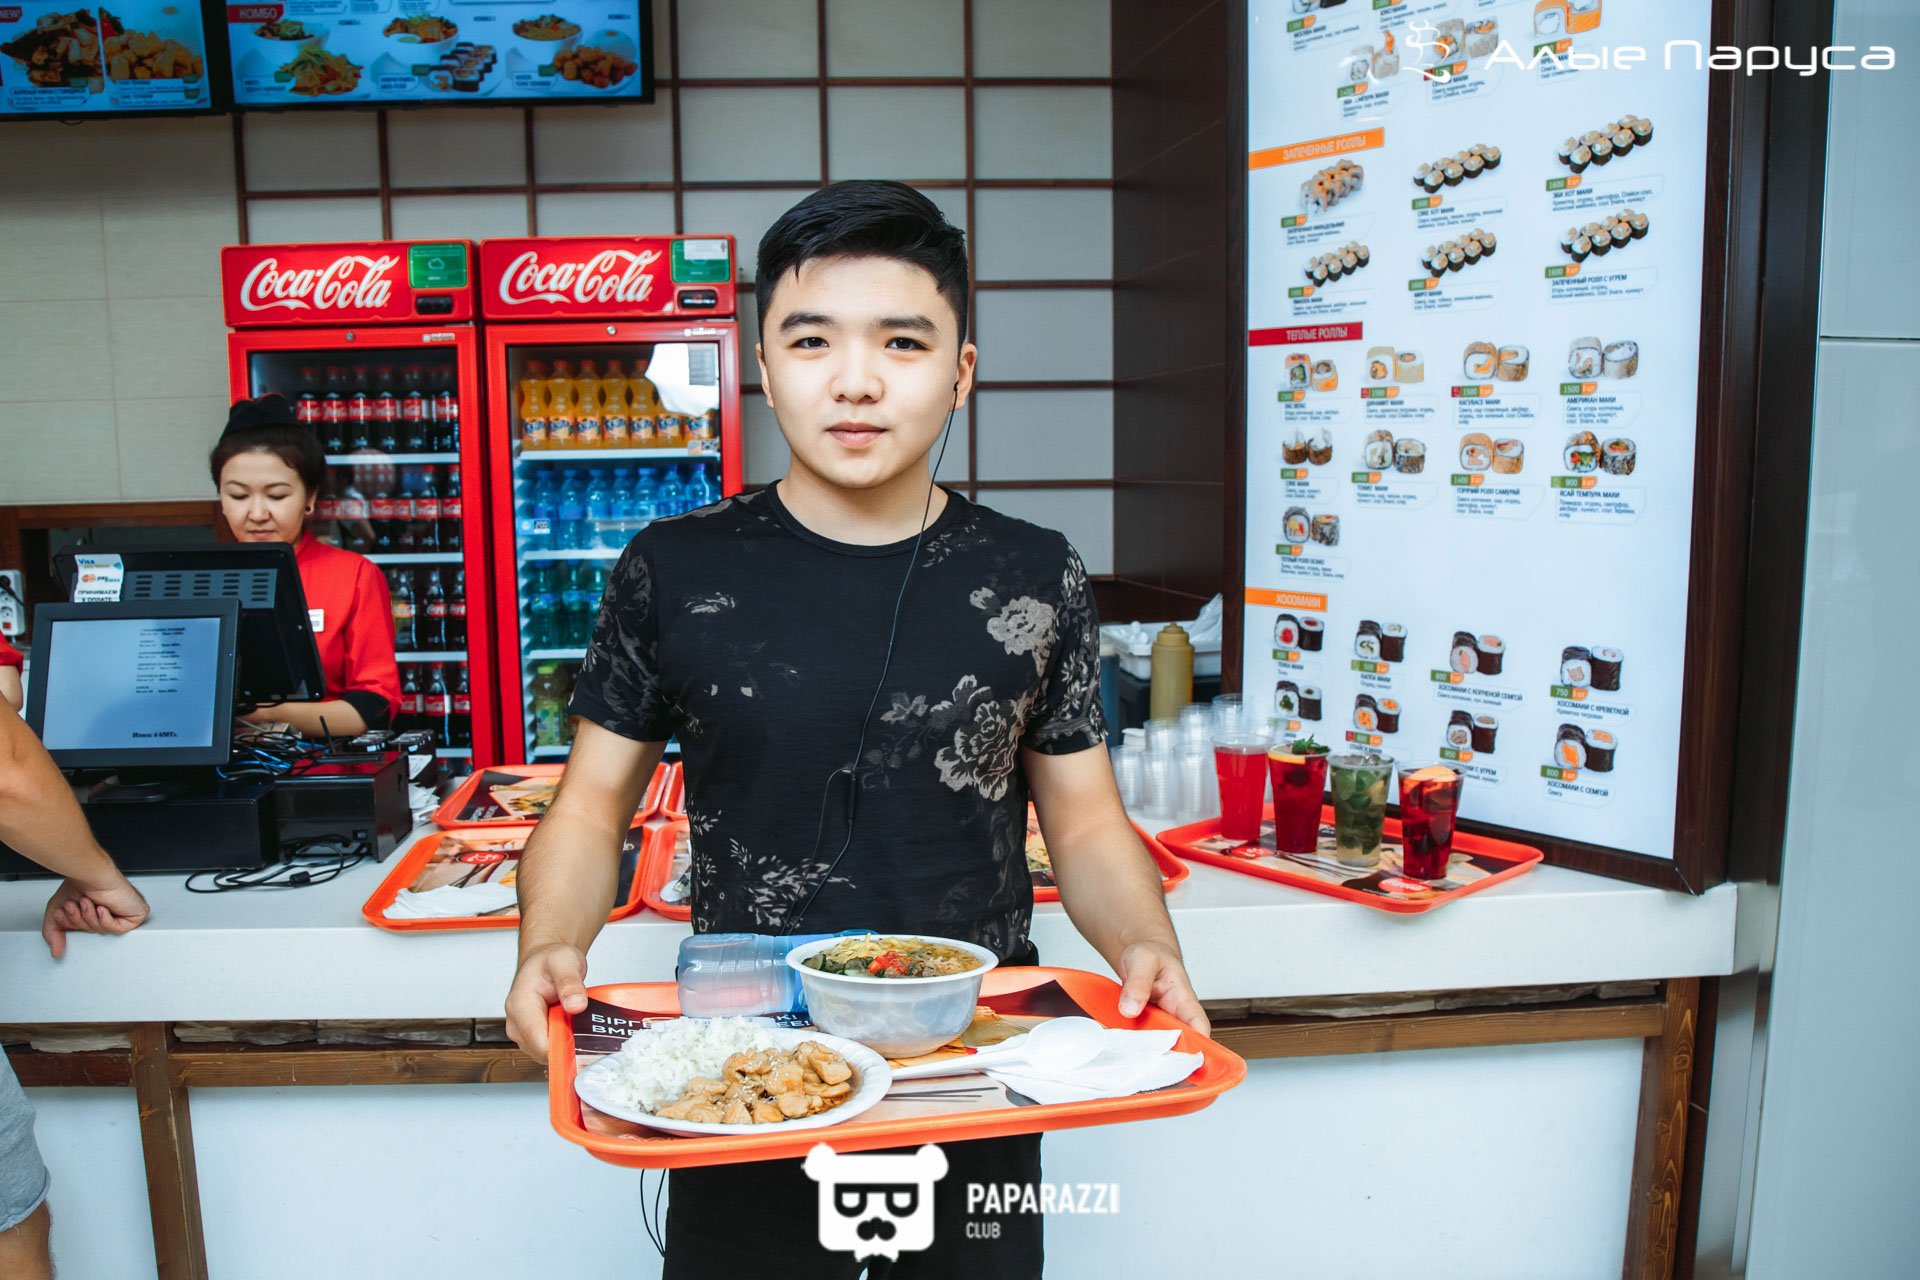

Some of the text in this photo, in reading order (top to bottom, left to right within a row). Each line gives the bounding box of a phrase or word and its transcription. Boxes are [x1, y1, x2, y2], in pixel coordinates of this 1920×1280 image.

[239, 8, 277, 19] КОМБО
[1336, 135, 1366, 153] РОЛЛЫ
[240, 254, 400, 311] Coca-Cola
[499, 248, 662, 306] Coca-Cola
[1286, 327, 1348, 341] ТЕПЛЫЕ РОЛЛЫ
[1563, 385, 1580, 394] 1500
[1560, 489, 1575, 498] ЯСАЙ
[1576, 490, 1602, 499] ТЕМПУРА
[1276, 593, 1321, 609] ХОСОМАКИ
[1556, 688, 1569, 698] 750
[1557, 700, 1589, 710] ХОСОМАКИ
[1595, 704, 1629, 716] КРЕВЕТКОЙ
[1480, 767, 1497, 776] УГРЕМ
[1547, 780, 1580, 791] ХОСОМАКИ
[1585, 786, 1609, 797] СЕМГОЙ
